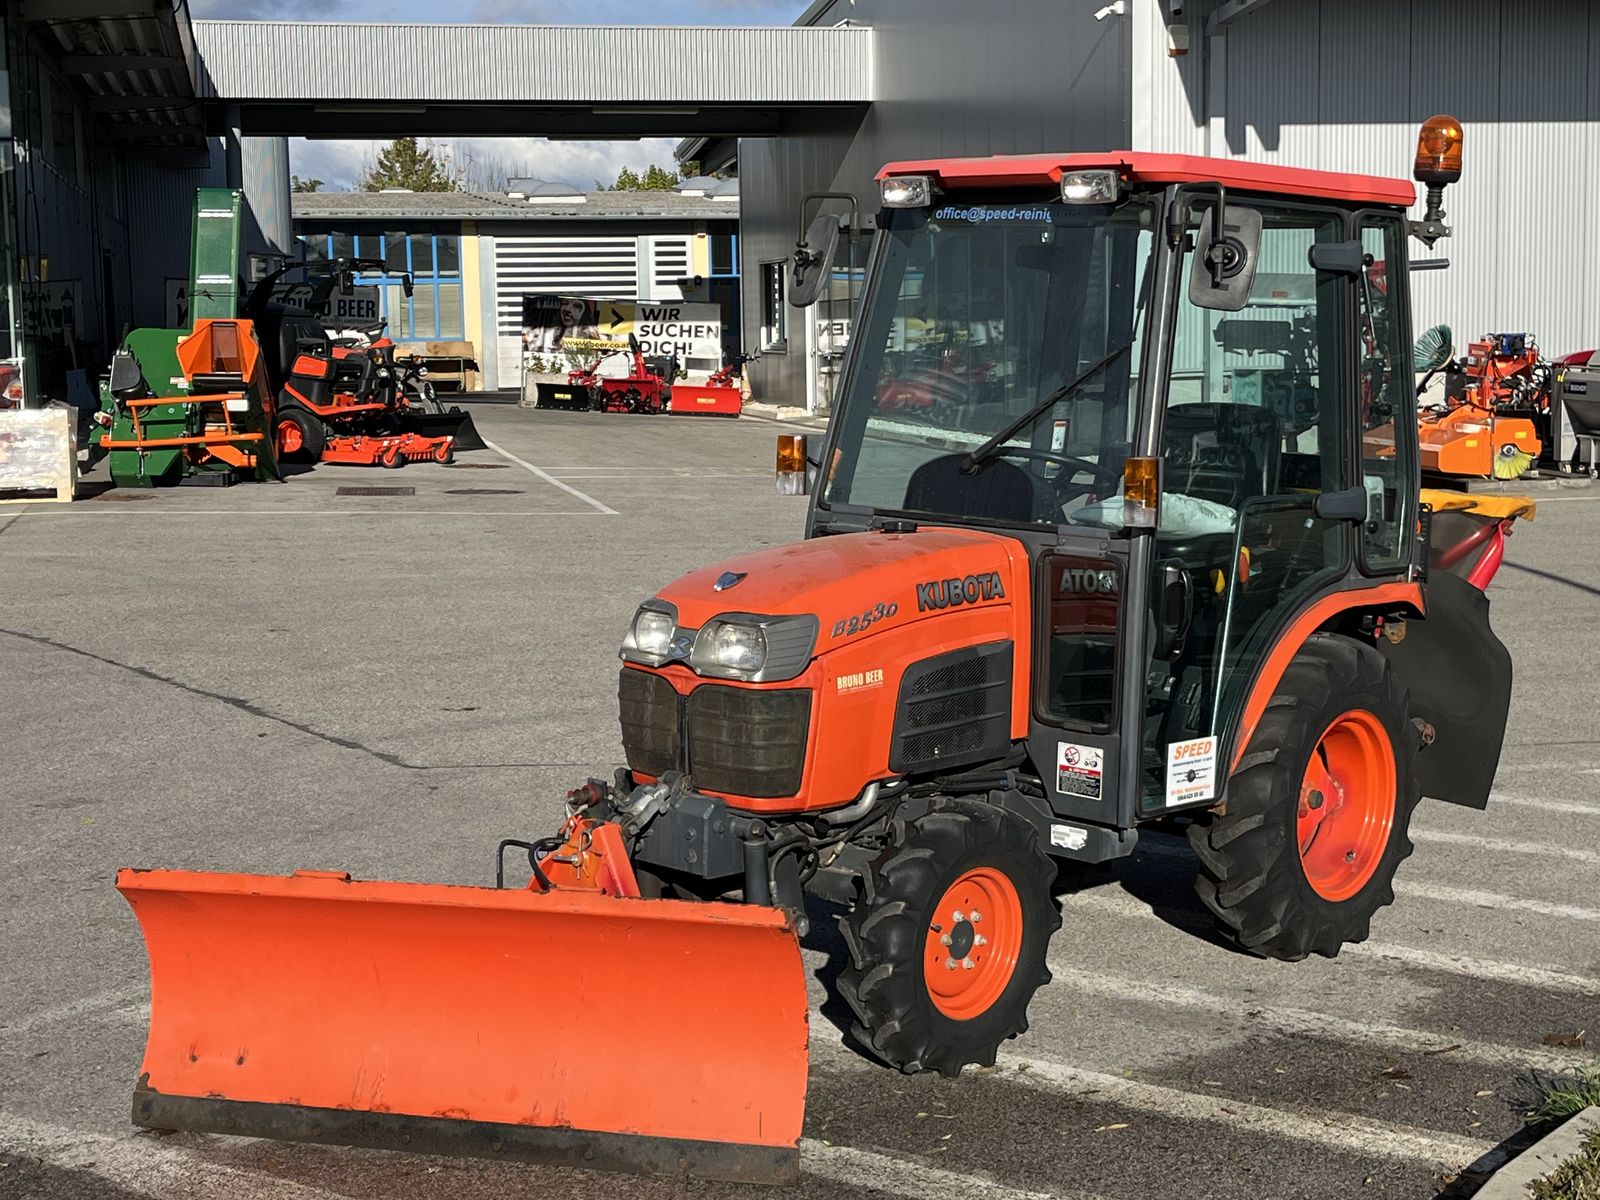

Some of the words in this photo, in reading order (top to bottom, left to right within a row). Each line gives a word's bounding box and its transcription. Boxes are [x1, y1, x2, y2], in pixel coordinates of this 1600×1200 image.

[338, 299, 376, 318] BEER
[641, 308, 681, 321] WIR
[639, 324, 720, 340] SUCHEN
[639, 341, 693, 356] DICH!
[916, 571, 1005, 612] KUBOTA
[831, 602, 898, 638] B2530
[837, 672, 864, 690] BRUNO
[865, 668, 883, 684] BEER
[1174, 741, 1212, 760] SPEED
